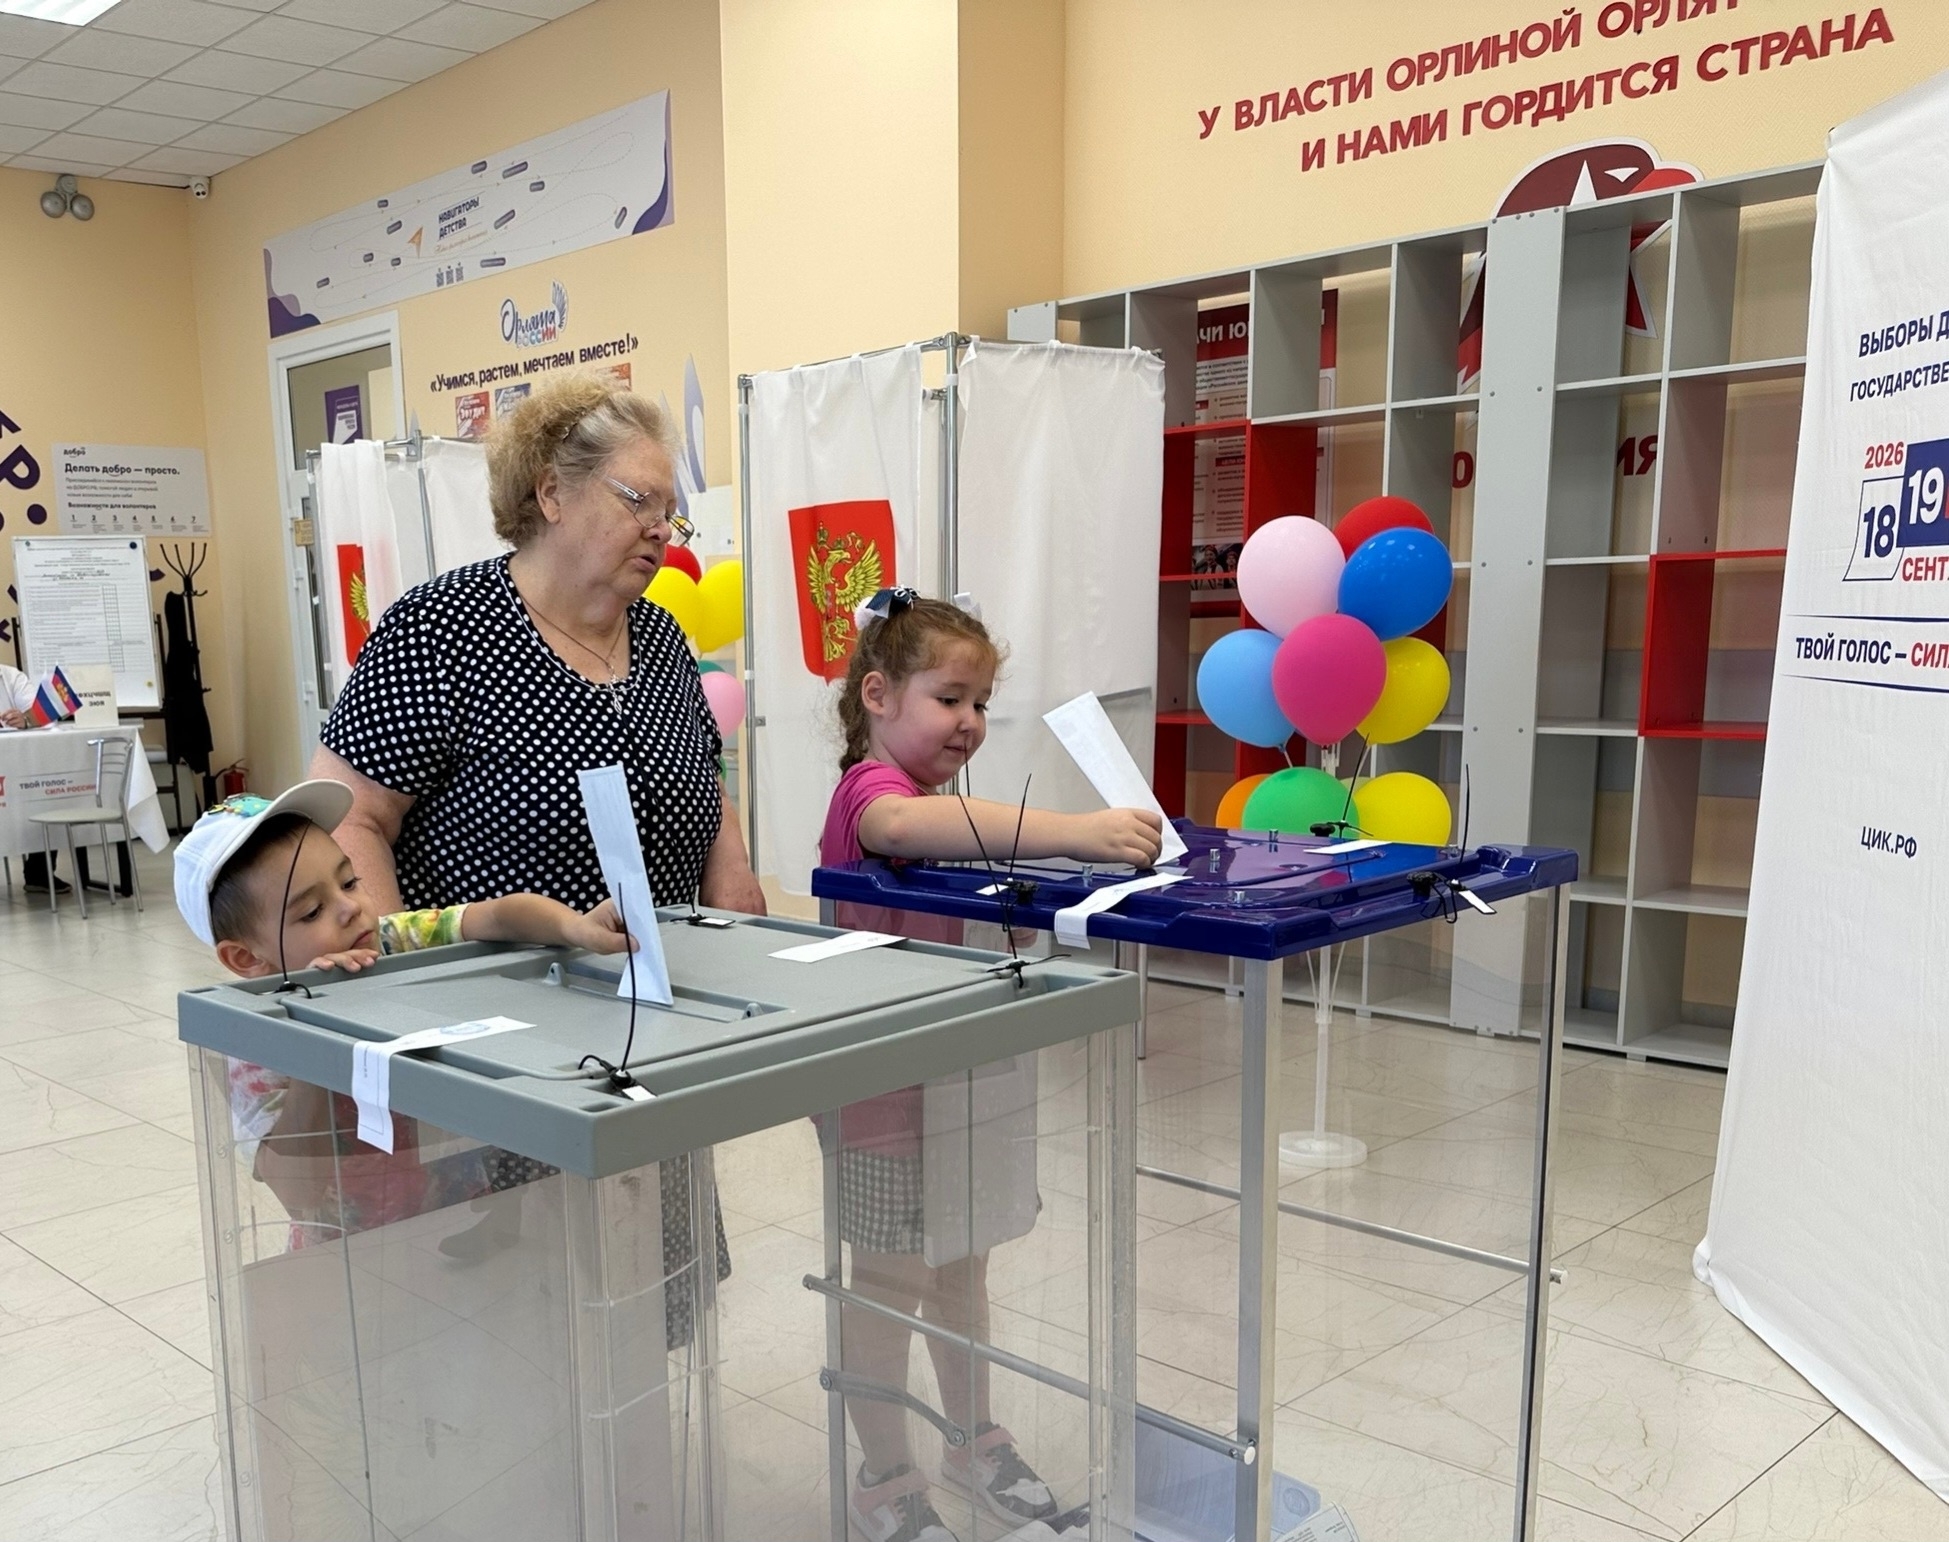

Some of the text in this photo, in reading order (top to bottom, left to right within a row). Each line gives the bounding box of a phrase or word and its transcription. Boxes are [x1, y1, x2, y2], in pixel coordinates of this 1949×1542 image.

[1198, 106, 1221, 139] У
[1235, 67, 1373, 131] ВЛАСТИ
[1386, 7, 1581, 91] ОРЛИНОЙ
[1301, 8, 1895, 172] И НАМИ ГОРДИТСЯ СТРАНА
[439, 217, 467, 240] ДЕТСТВА
[1197, 321, 1250, 344] ЧИ Ю
[1859, 315, 1934, 358] ВЫБОРЫ
[478, 363, 522, 388] растем,
[523, 350, 575, 374] мечтаем
[579, 332, 639, 363] вместе!»
[1850, 361, 1949, 402] ГОСУДАРСТВЕ
[64, 463, 100, 473] Делать
[102, 464, 132, 475] добро
[145, 467, 180, 476] просто.
[1864, 441, 1905, 470] 2026
[1863, 466, 1945, 558] 18 19
[1902, 556, 1949, 582] СЕНТ
[1795, 632, 1835, 661] ТВОЙ
[1837, 639, 1892, 665] ГОЛОС
[1911, 642, 1949, 669] СИЛ
[19, 780, 40, 790] ТВОЙ
[41, 779, 67, 787] ГОЛОС
[45, 784, 97, 795] СИЛА РОССИИ
[1860, 826, 1918, 859] ЦИК.РФ
